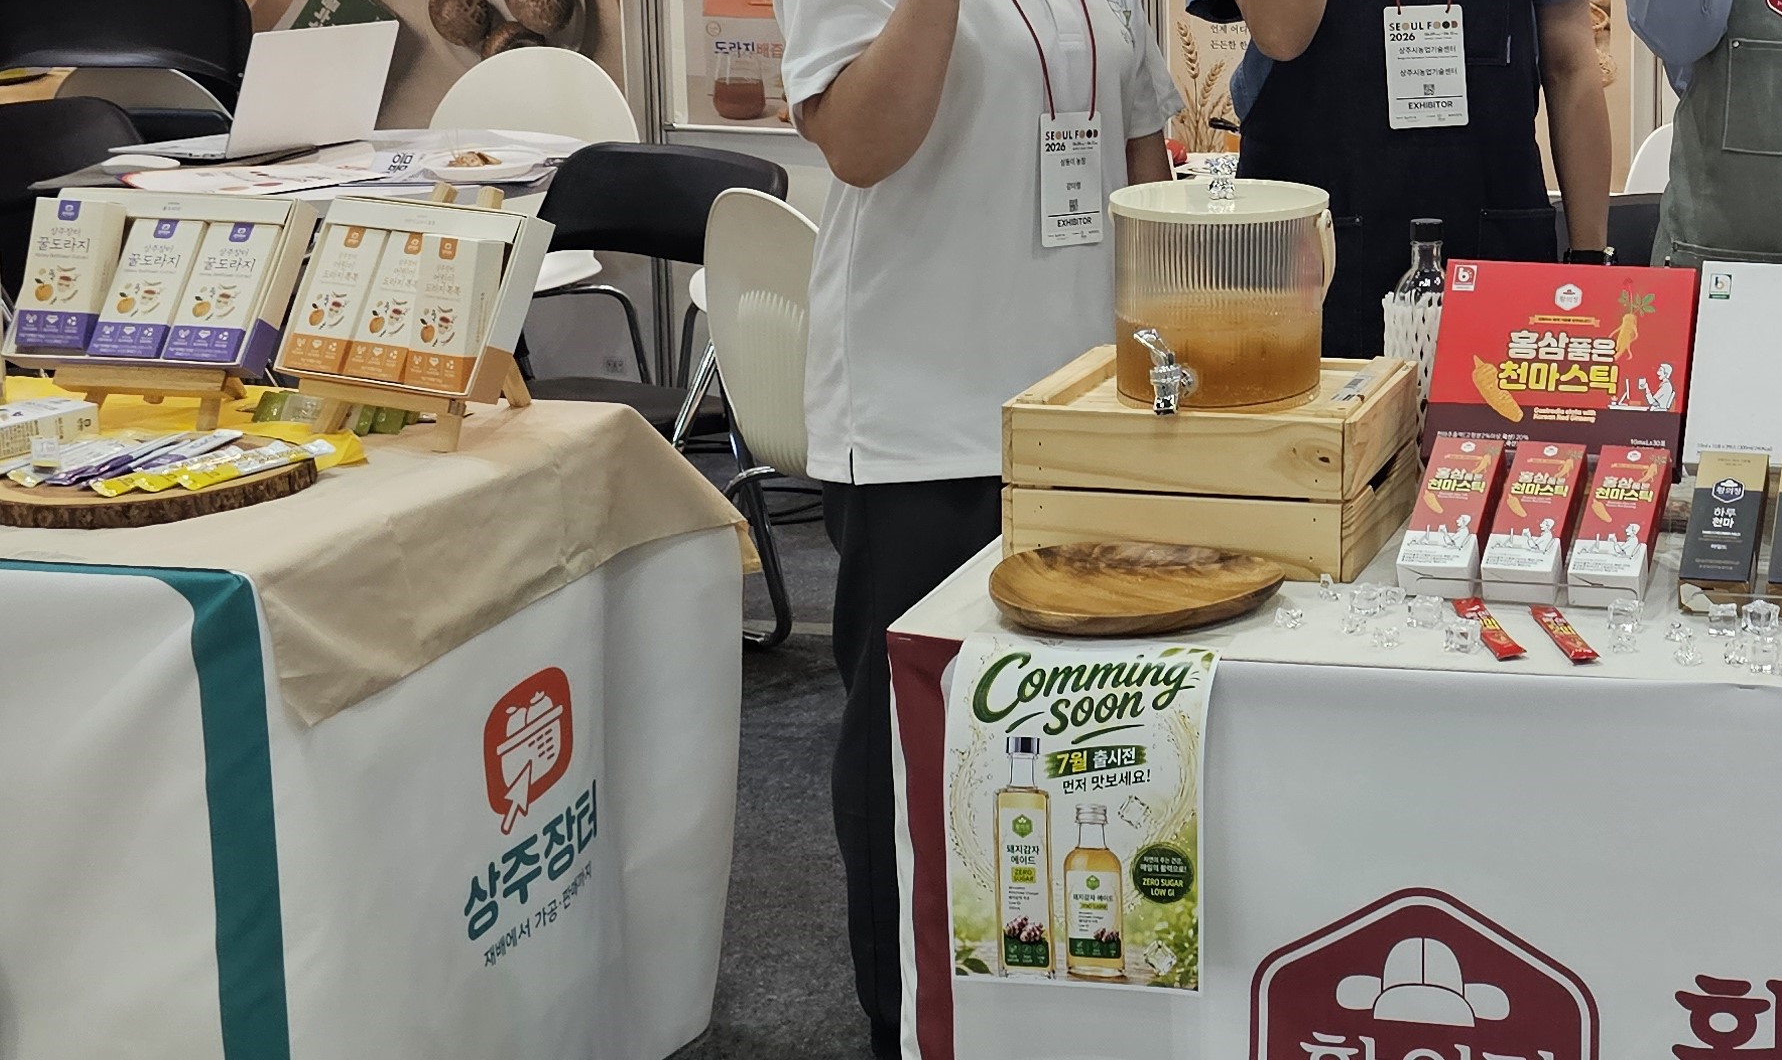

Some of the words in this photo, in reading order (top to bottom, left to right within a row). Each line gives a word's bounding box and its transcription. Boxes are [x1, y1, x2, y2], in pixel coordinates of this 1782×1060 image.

[1389, 22, 1424, 31] SEOUL
[1427, 21, 1458, 29] FOOD
[1389, 33, 1416, 42] 2026
[1399, 46, 1456, 54] 상주시농업기술센터
[1400, 67, 1457, 77] 상주시농업기술센터
[1408, 101, 1453, 109] EXHIBITOR
[1045, 130, 1072, 141] SEOUL
[1075, 129, 1098, 139] FOOD
[1045, 142, 1066, 152] 2026
[1057, 217, 1092, 227] EXHIBITOR
[37, 237, 90, 253] 꿀도라지
[128, 254, 181, 267] 꿀도라지
[203, 257, 256, 271] 꿀도라지
[1508, 330, 1617, 362] 홍삼품은
[1498, 361, 1619, 395] 천마스틱
[1427, 479, 1487, 493] 천마스틱
[1511, 482, 1569, 498] 천마스틱
[1716, 486, 1741, 496] 황의정
[1595, 487, 1654, 502] 천마스틱
[1714, 507, 1737, 517] 하루
[1712, 517, 1735, 529] 천마
[973, 652, 1196, 723] Comming
[1043, 691, 1145, 735] soon
[1057, 752, 1087, 774] 7월
[1093, 747, 1136, 769] 출시전
[1063, 777, 1087, 794] 먼저
[1091, 770, 1150, 791] 맛보세요!
[1006, 845, 1039, 856] 돼지감자
[464, 779, 597, 940] 상주장터
[1011, 855, 1036, 865] 에이드
[1014, 875, 1034, 883] SUGAR
[1142, 878, 1159, 886] ZERO
[1161, 879, 1183, 887] SUGAR
[1151, 888, 1166, 896] LOW
[484, 918, 531, 967] 재배에서
